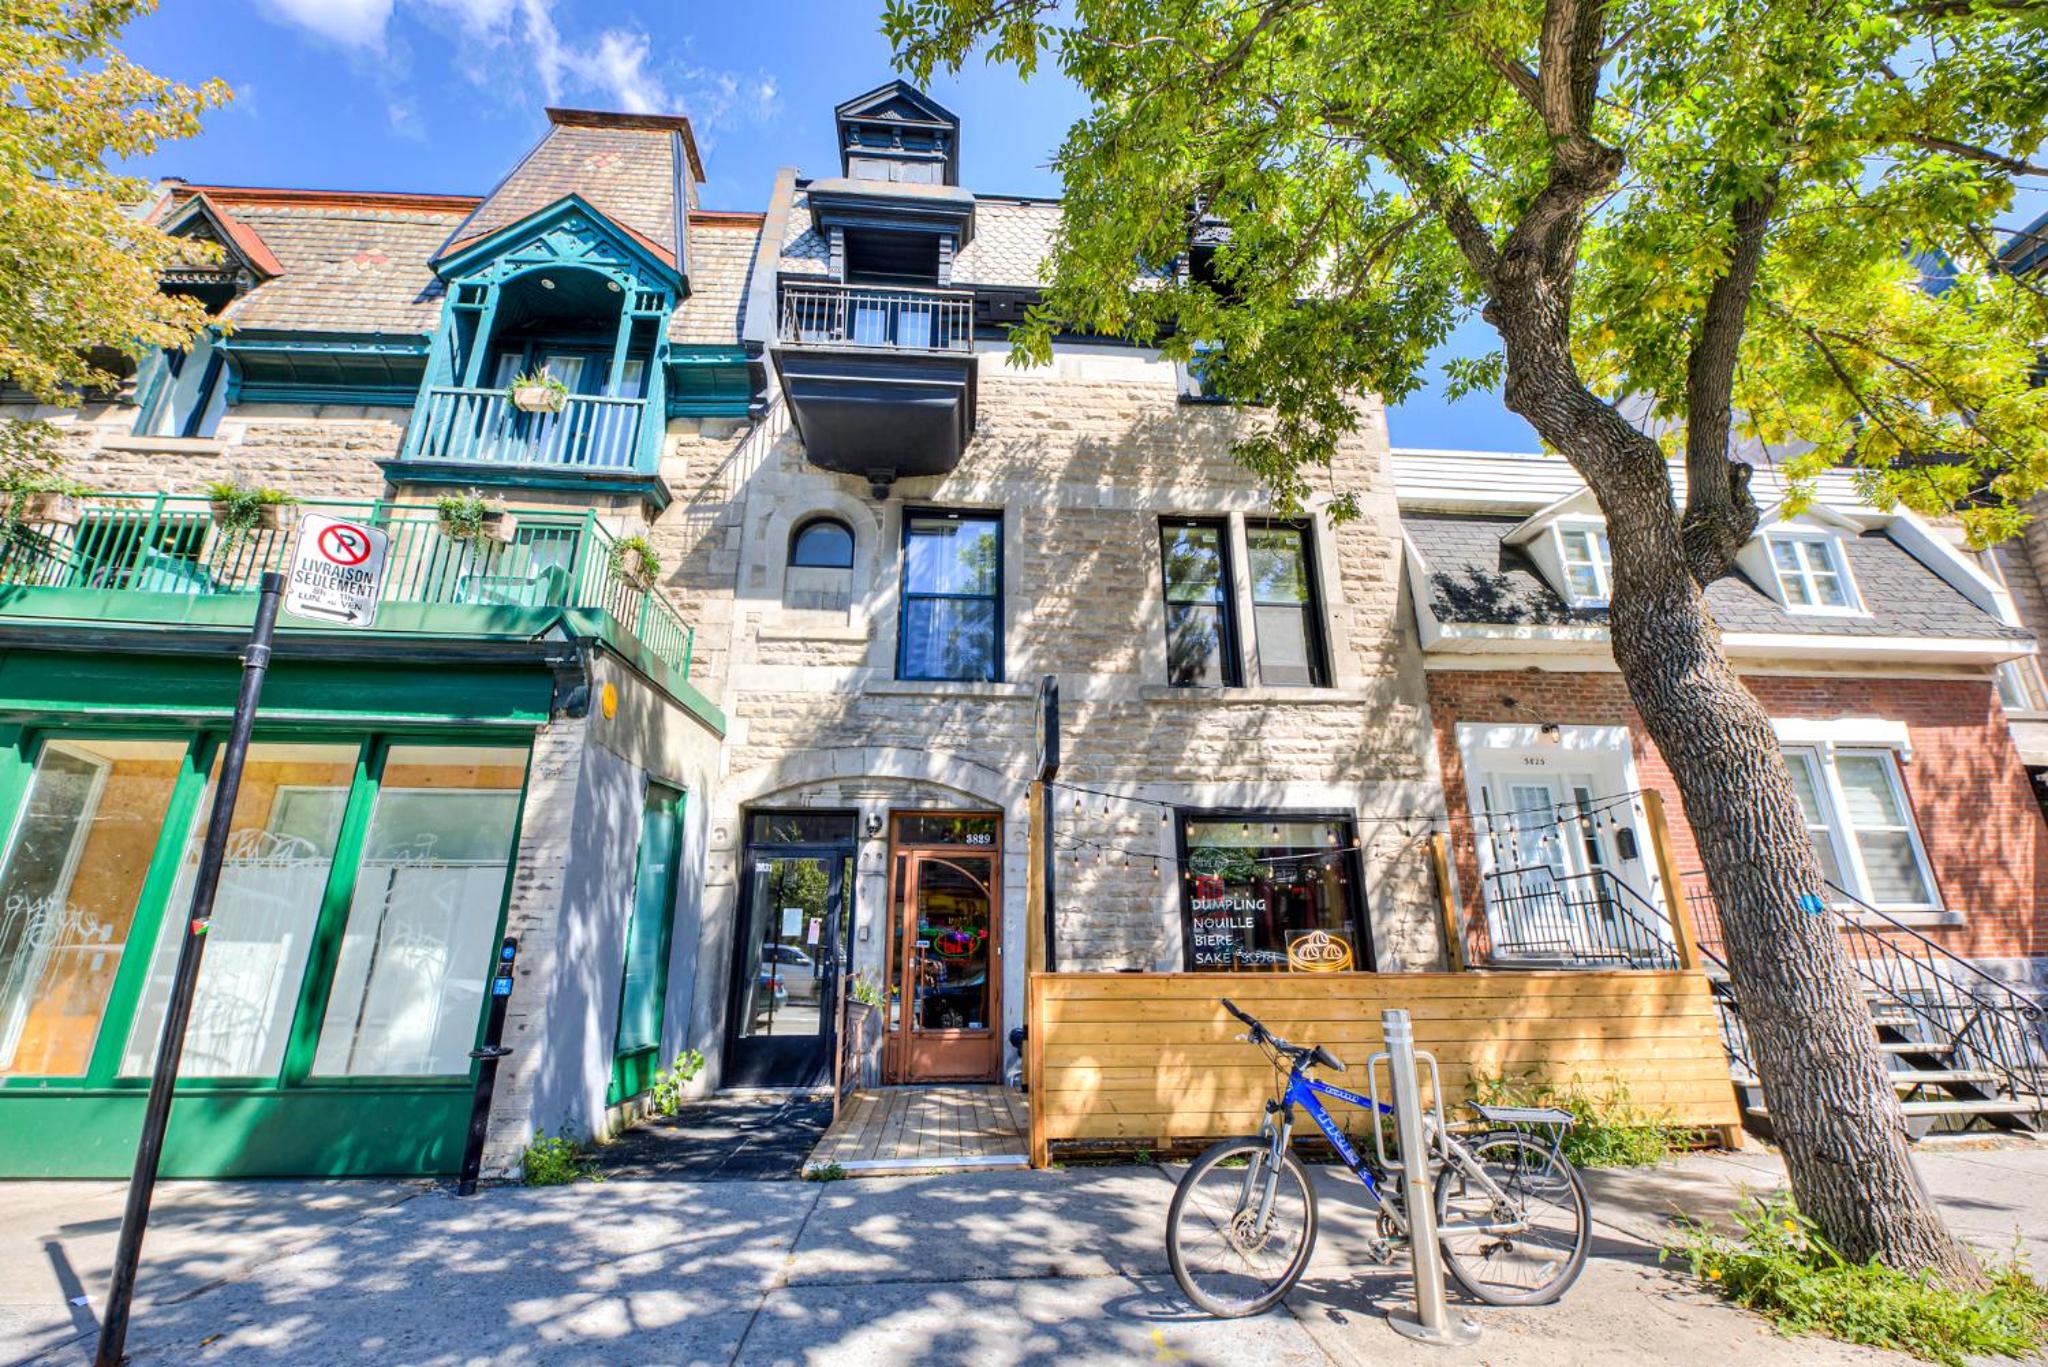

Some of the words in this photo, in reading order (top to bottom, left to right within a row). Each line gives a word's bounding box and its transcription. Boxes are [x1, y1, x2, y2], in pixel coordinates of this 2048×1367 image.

[301, 557, 374, 584] LIVRAISON
[294, 569, 375, 598] SEULEMENT
[1192, 899, 1266, 911] DUMPLING
[1194, 917, 1255, 929] NOUILLE
